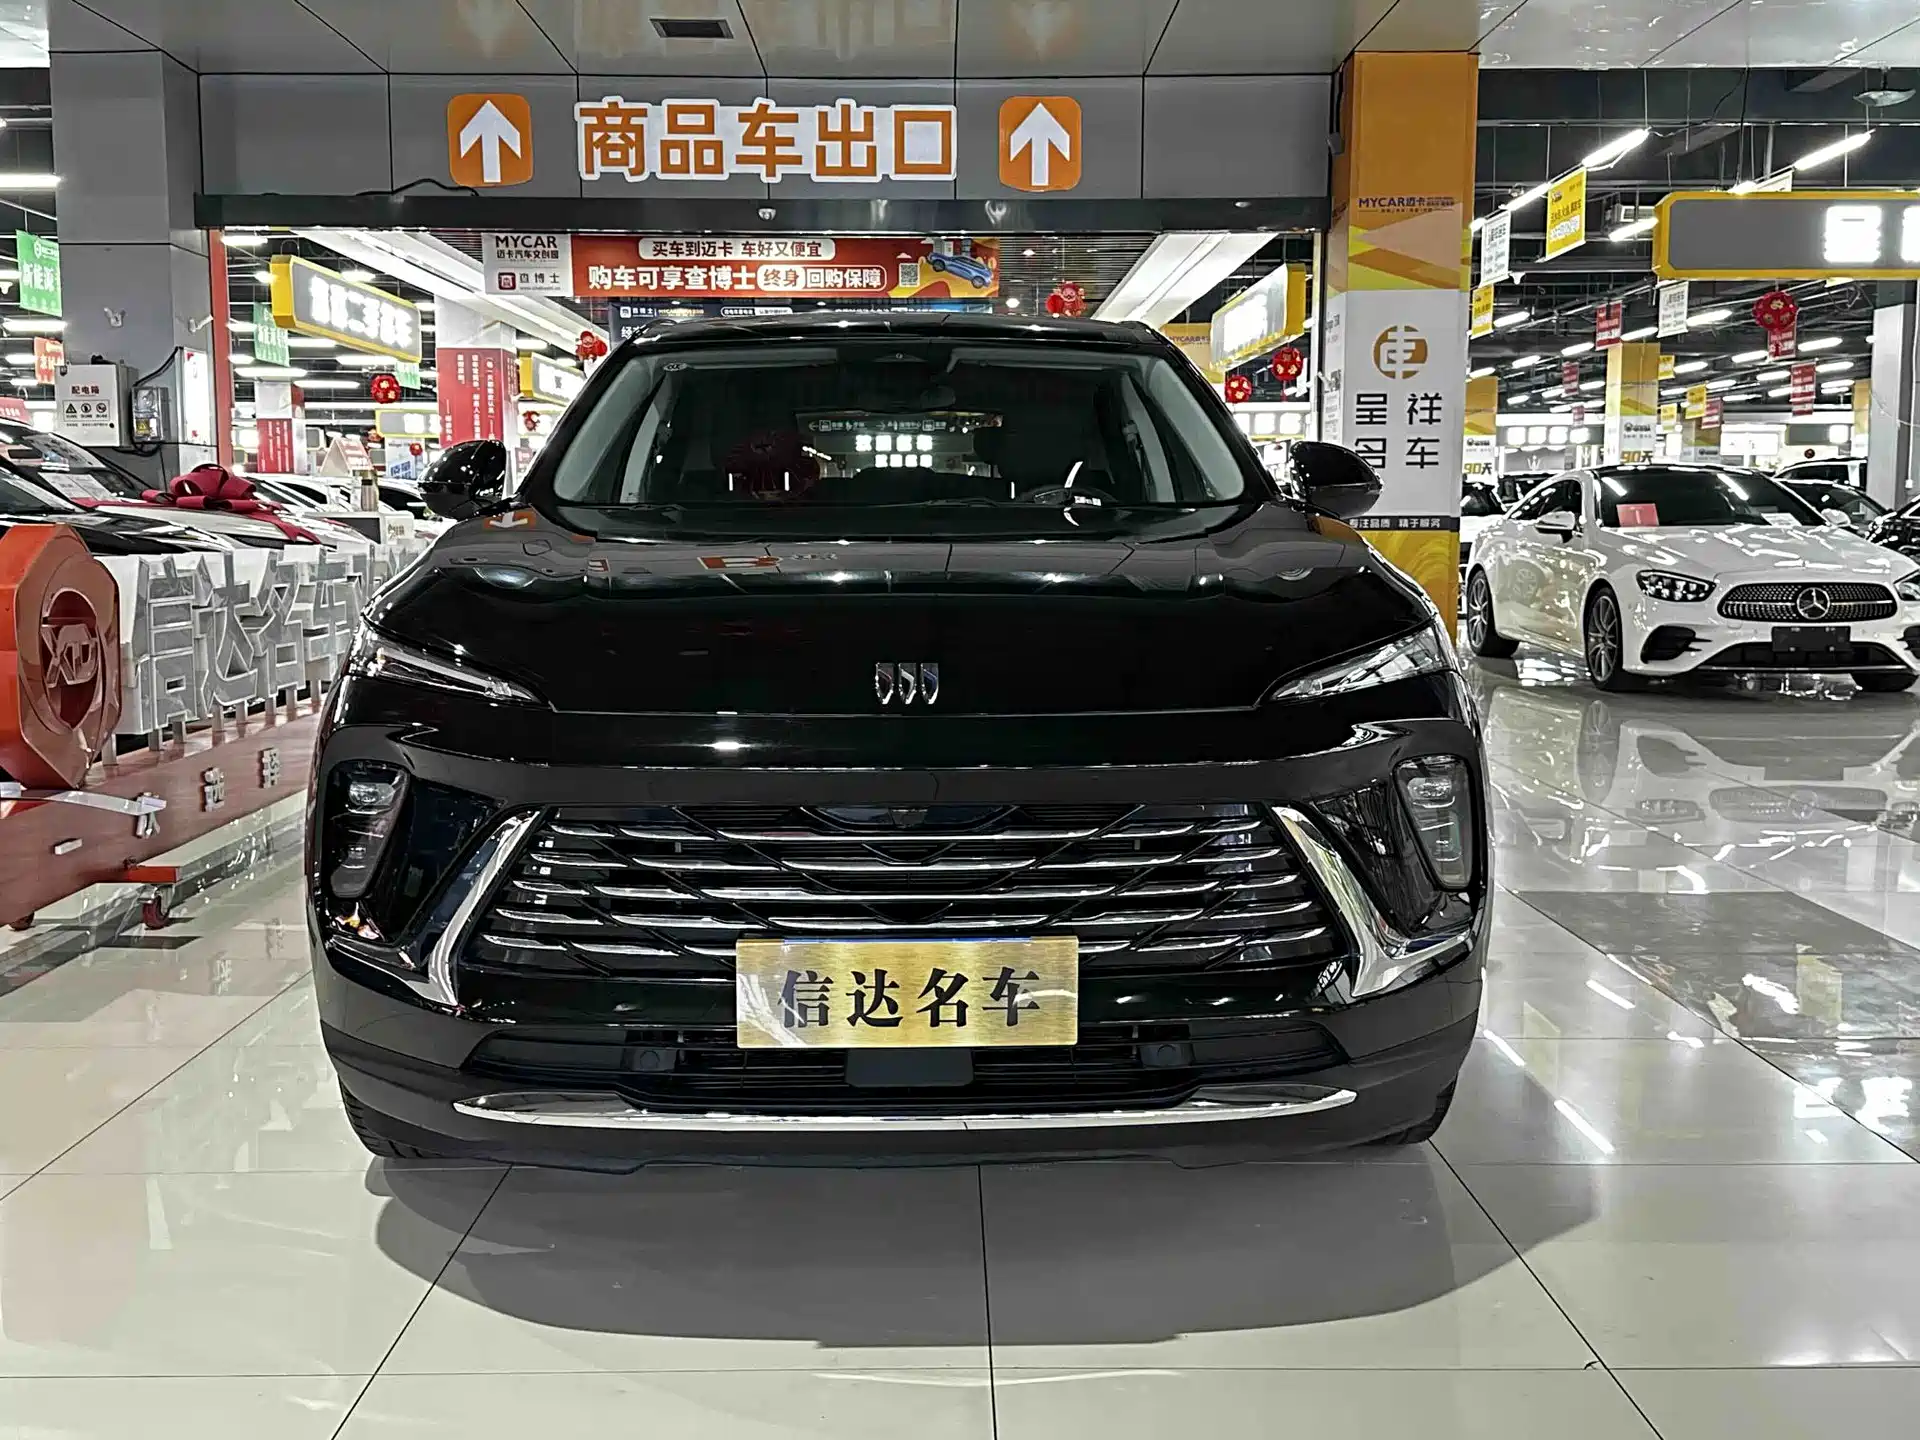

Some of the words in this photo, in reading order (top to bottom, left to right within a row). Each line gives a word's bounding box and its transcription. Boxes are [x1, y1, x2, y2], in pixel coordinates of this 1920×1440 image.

[579, 101, 952, 178] 商品车出口
[495, 235, 558, 248] MYCAR
[652, 240, 733, 258] 买车到迈卡
[740, 240, 822, 258] 车好又便宜
[496, 249, 559, 260] 迈卡汽车文创园
[519, 272, 560, 284] 查博士
[588, 265, 882, 291] 购车可享查博士终身回购保障
[71, 385, 100, 395] 配电箱
[1355, 392, 1442, 425] 呈祥
[1354, 437, 1440, 469] 名车
[1463, 462, 1493, 475] 90天
[1398, 518, 1441, 528] 精于服务
[777, 967, 1040, 1028] 信达名车
